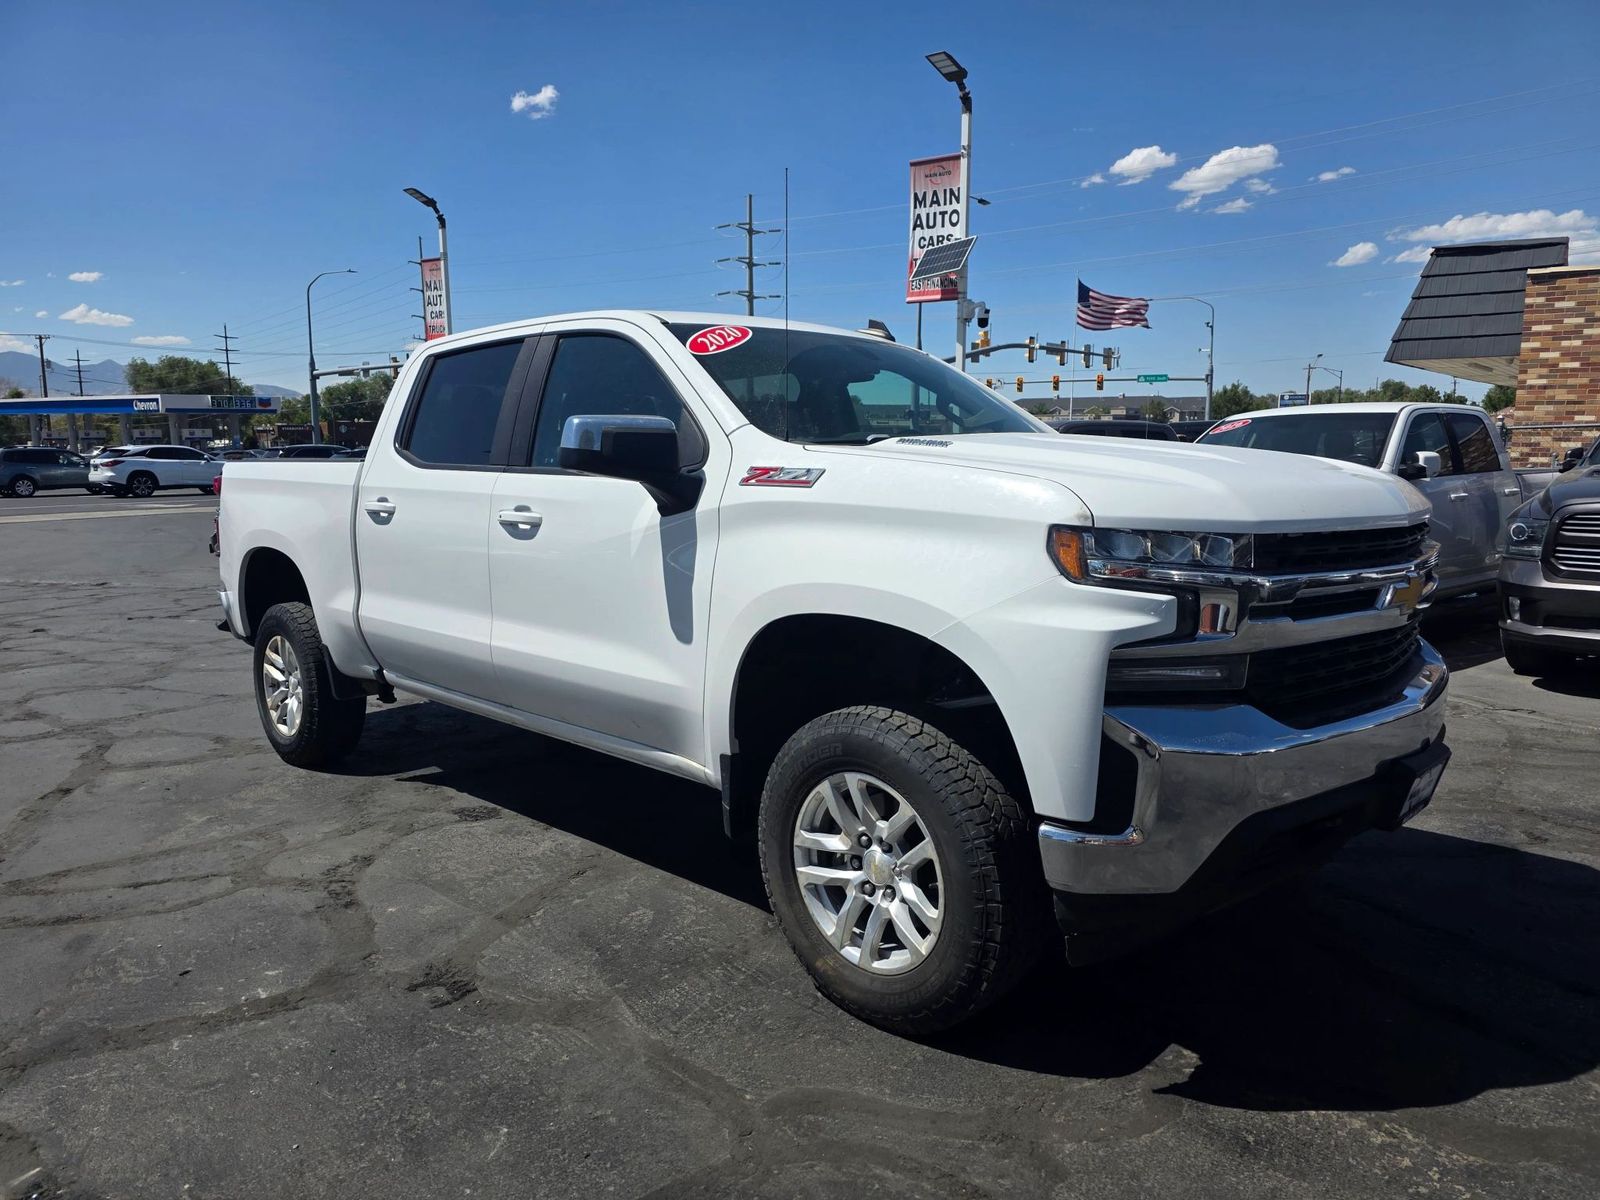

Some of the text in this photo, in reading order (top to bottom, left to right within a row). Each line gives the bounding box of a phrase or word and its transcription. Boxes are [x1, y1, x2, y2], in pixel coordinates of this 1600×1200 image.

[913, 187, 960, 209] MAIN
[913, 209, 960, 231] AUTO
[918, 234, 954, 249] CARS
[697, 326, 742, 352] 2020
[133, 399, 158, 411] Chevron
